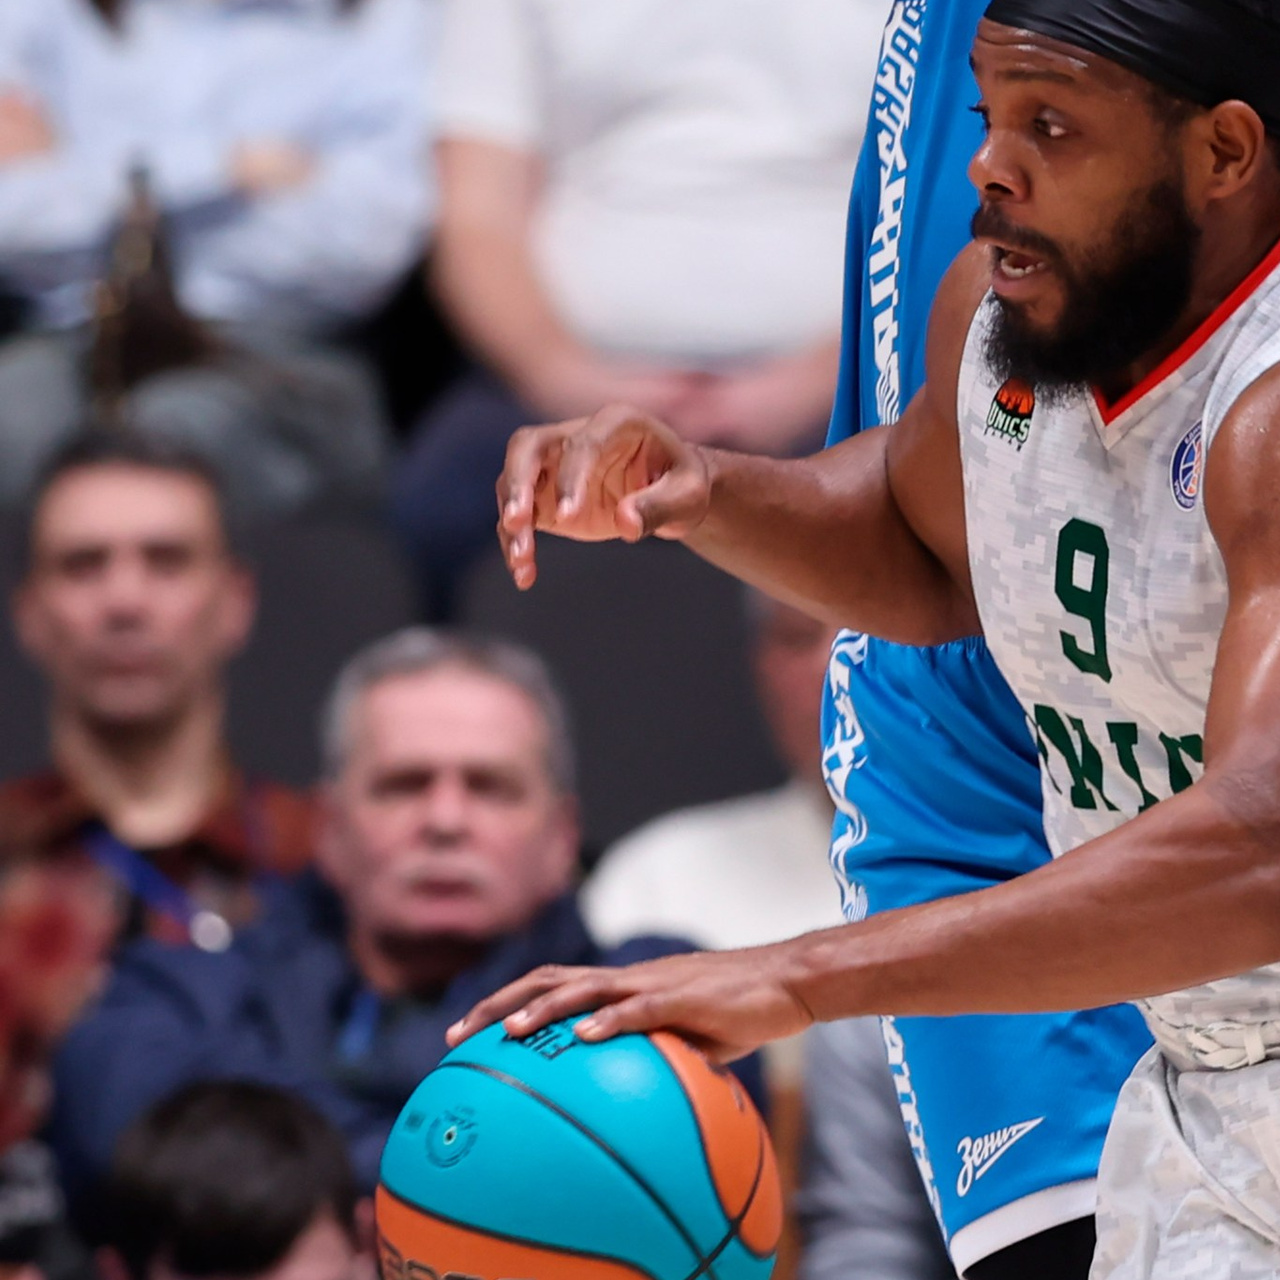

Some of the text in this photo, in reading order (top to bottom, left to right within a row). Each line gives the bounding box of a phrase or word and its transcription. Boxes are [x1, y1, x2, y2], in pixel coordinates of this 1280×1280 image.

[987, 400, 1031, 443] UNICS
[1055, 517, 1112, 684] 9
[957, 1116, 1045, 1197] Зенит
